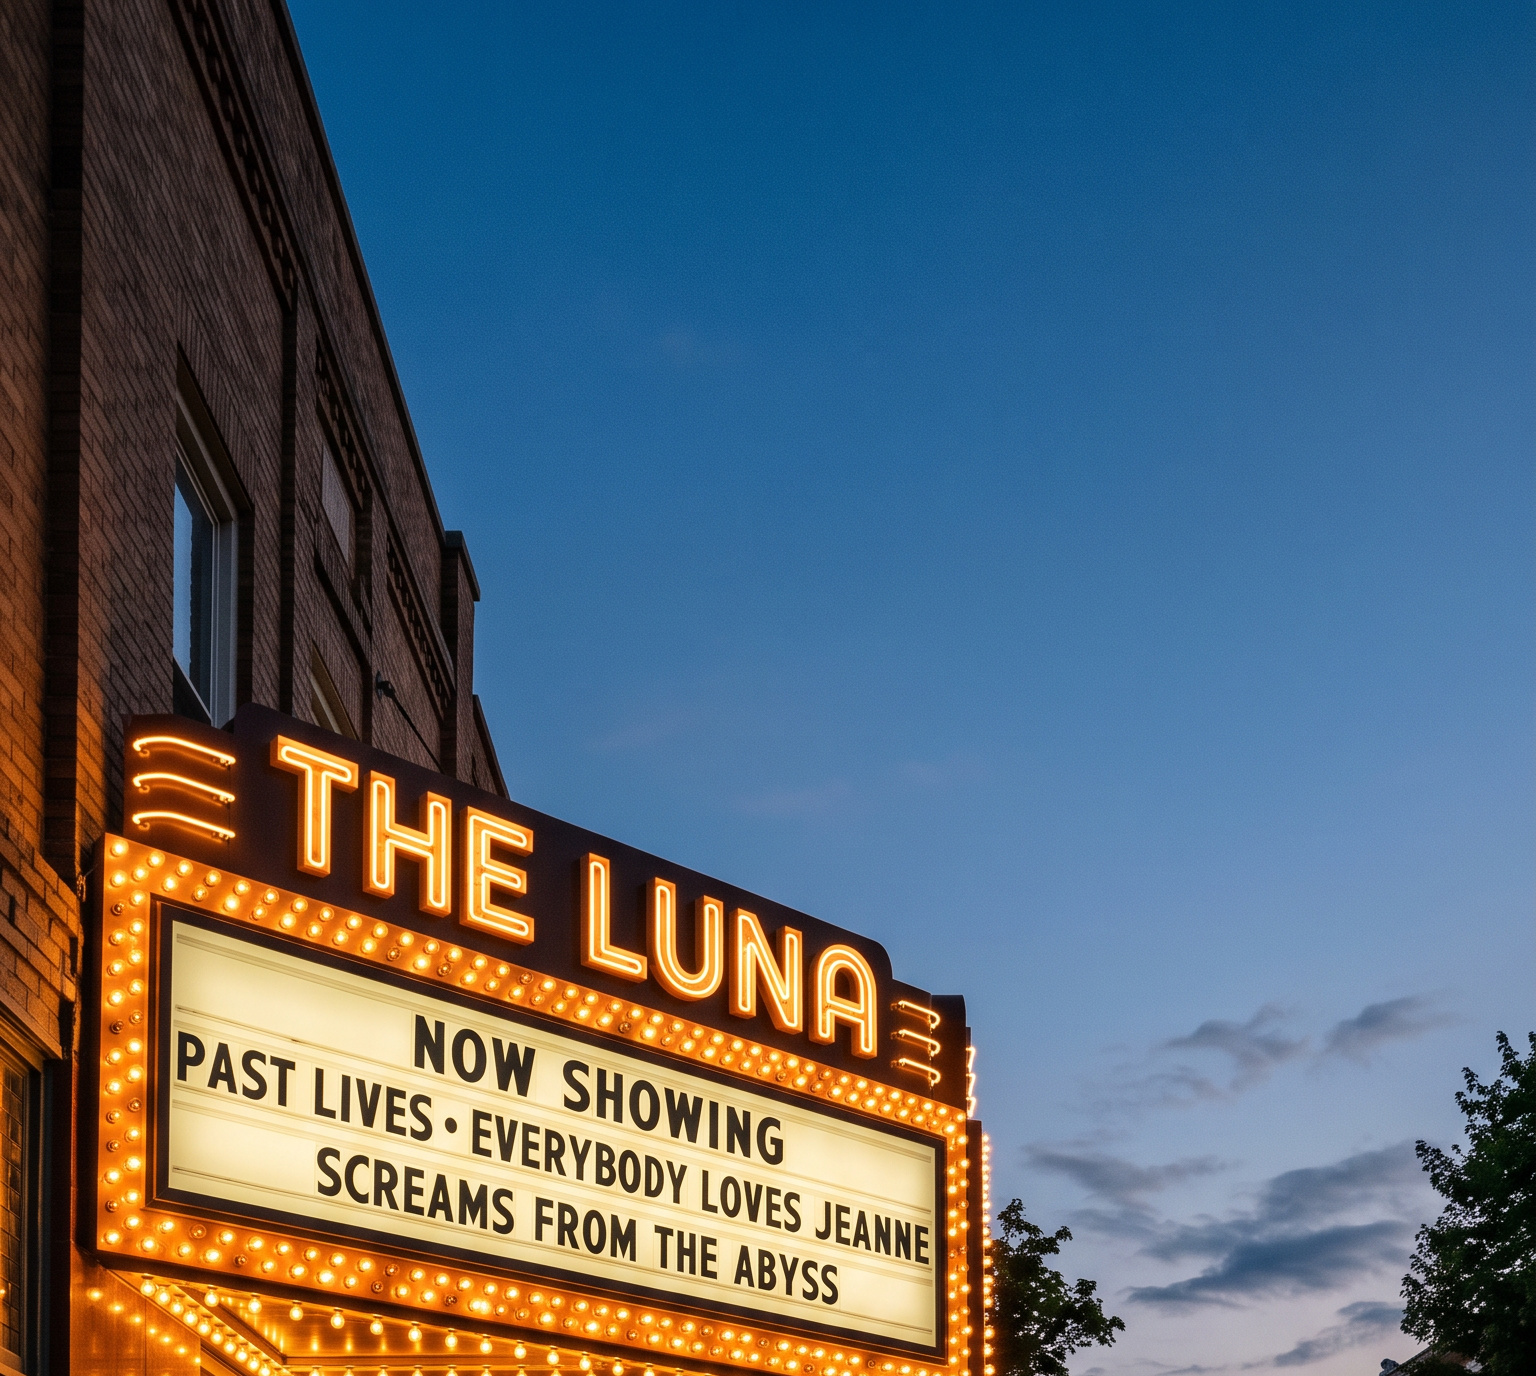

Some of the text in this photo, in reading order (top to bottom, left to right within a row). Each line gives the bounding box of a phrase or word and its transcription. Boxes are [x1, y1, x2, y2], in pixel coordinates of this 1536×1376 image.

[270, 734, 877, 1059] THE LUNA
[176, 1030, 930, 1265] PAST LIVES EVERYBODY LOVES JEANNE
[414, 1014, 784, 1166] NOW SHOWING
[316, 1147, 839, 1306] SCREAMS FROM THE ABYSS
